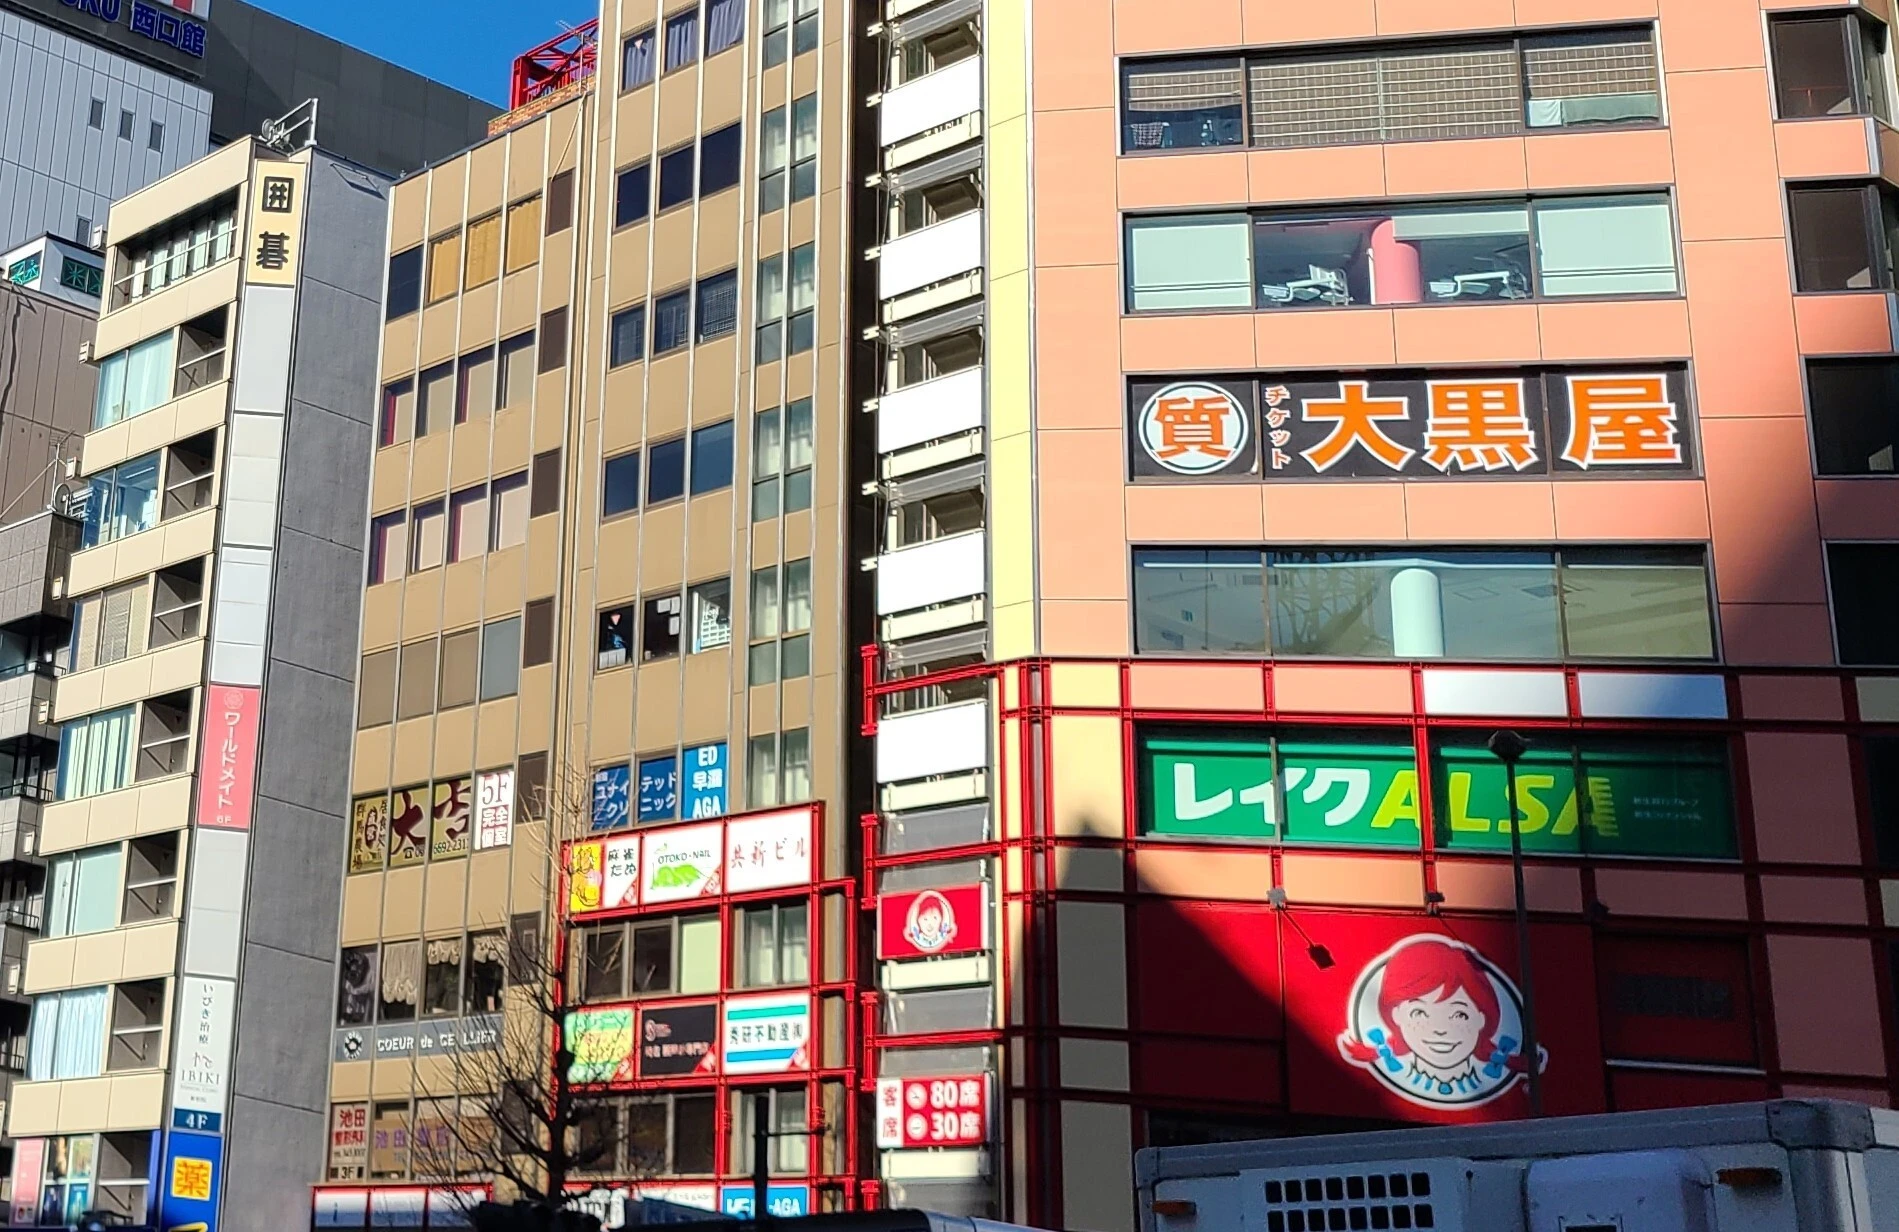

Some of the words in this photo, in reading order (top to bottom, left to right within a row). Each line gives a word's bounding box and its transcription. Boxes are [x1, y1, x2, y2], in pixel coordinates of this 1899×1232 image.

[131, 2, 208, 59] 西口館
[256, 176, 295, 270] 囲碁
[1154, 394, 1233, 460] 質
[1264, 384, 1290, 470] チケット
[1300, 374, 1684, 474] 大黒屋
[218, 711, 241, 810] ワールドメイト
[698, 746, 718, 766] ED
[482, 773, 510, 805] 5F
[482, 805, 509, 827] 完全
[692, 796, 721, 819] AGA
[377, 1036, 414, 1052] COEUR
[420, 1035, 434, 1049] de
[186, 1113, 208, 1130] 4F
[339, 1108, 366, 1128] 池田
[176, 1161, 211, 1199] 薬
